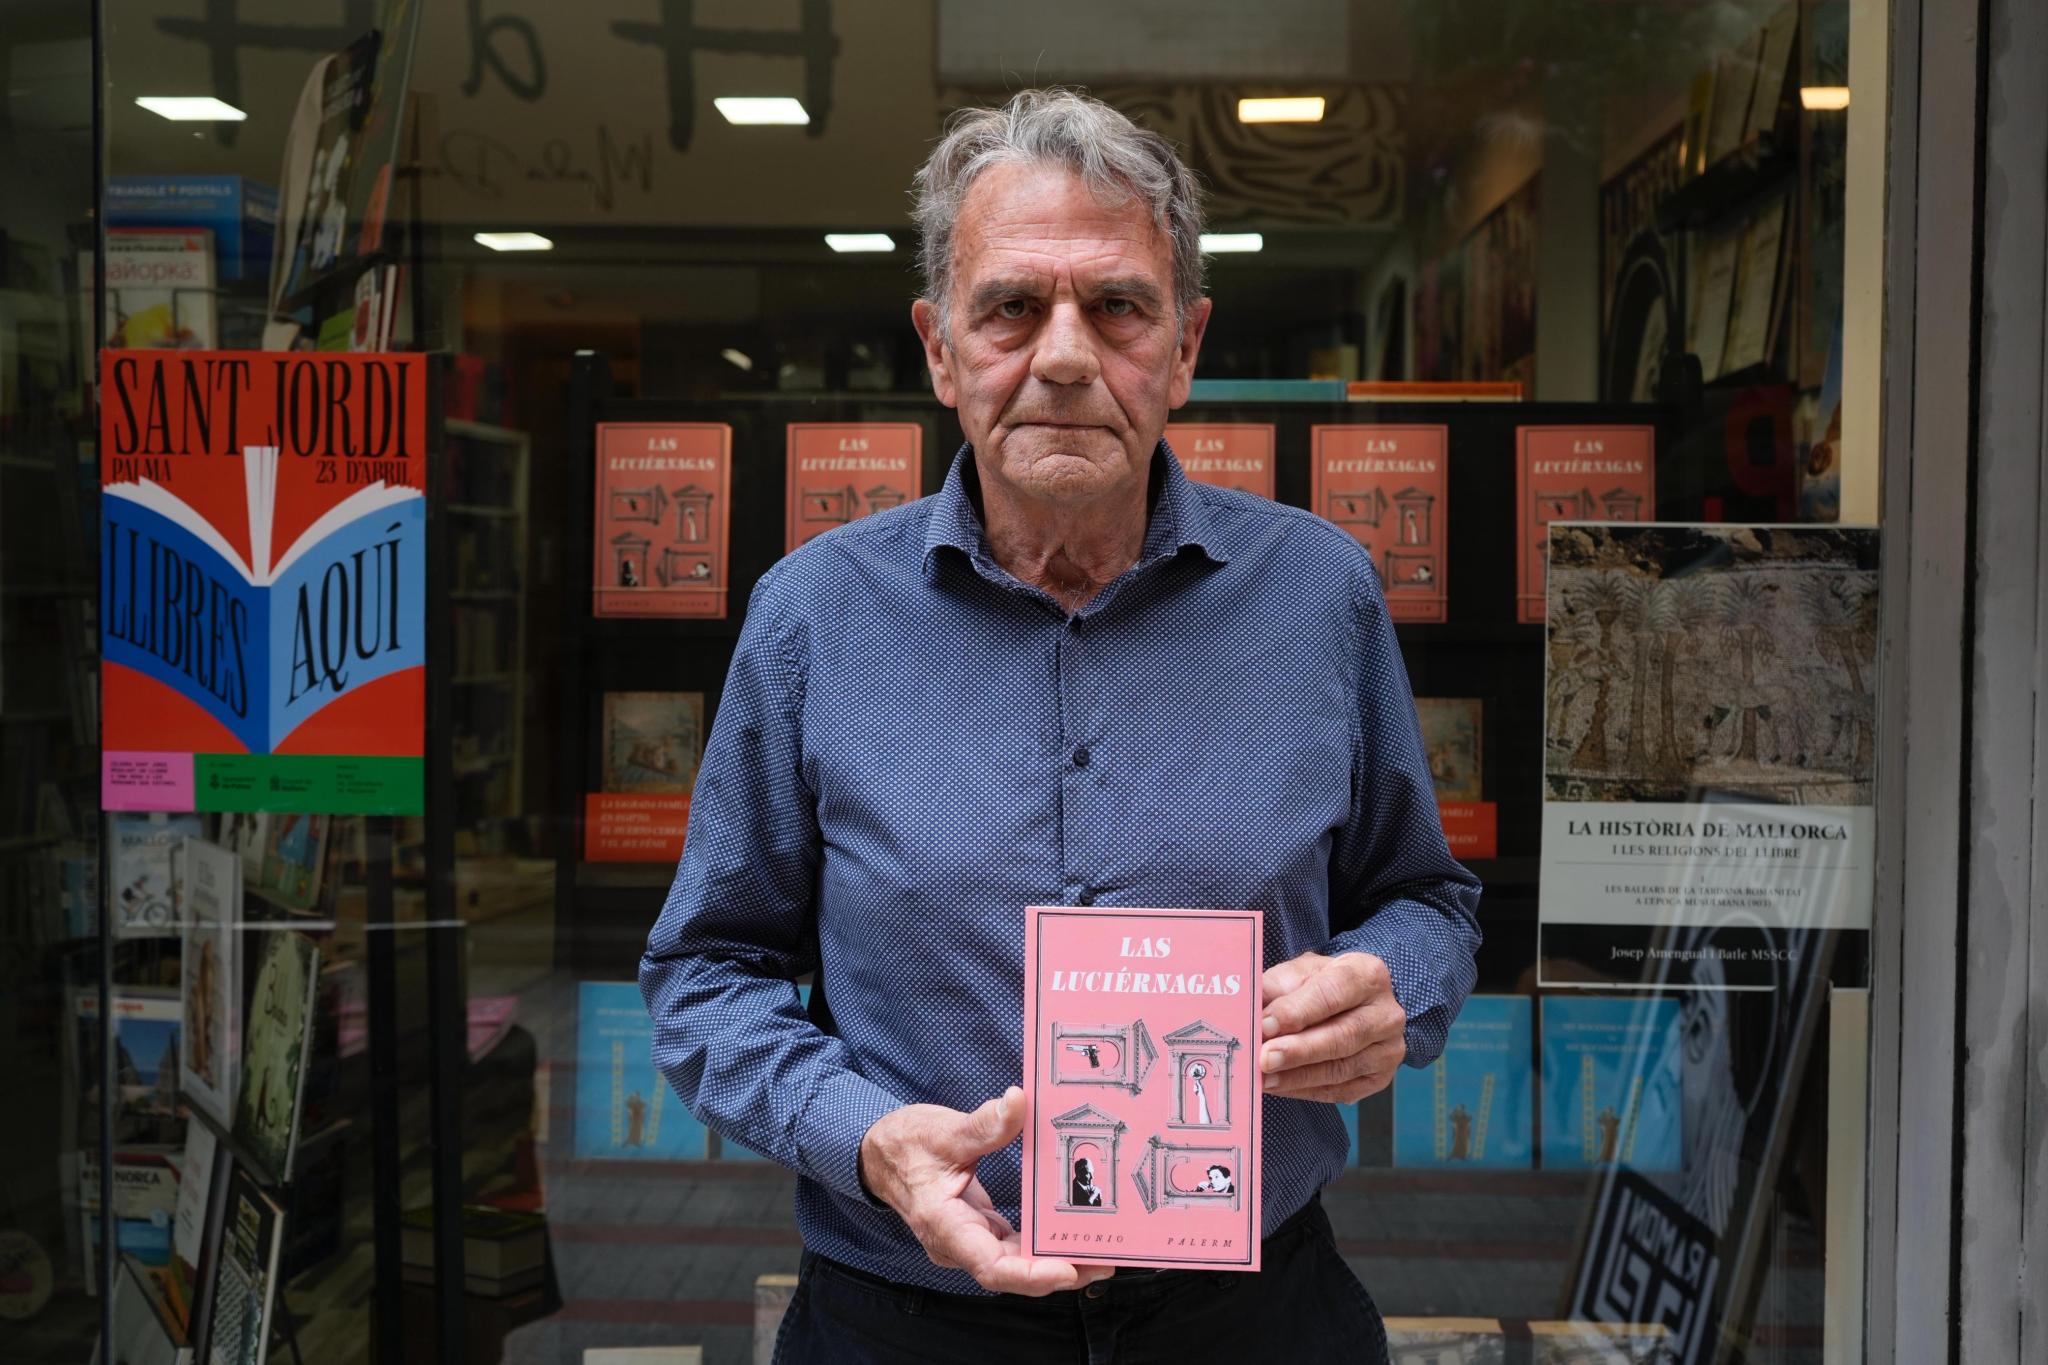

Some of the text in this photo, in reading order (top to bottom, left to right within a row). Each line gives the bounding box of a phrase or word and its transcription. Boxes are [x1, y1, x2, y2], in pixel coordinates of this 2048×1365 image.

[114, 358, 410, 457] SANT JORDI
[648, 437, 678, 451] LAS
[839, 437, 869, 451] LAS
[1194, 438, 1225, 452] LAS
[1366, 439, 1398, 453] LAS
[1573, 440, 1605, 454] LAS
[112, 458, 172, 481] PALMA
[610, 454, 716, 471] LUCIÉRNAGAS
[800, 455, 907, 471] LUCIÉRNAGAS
[1184, 455, 1264, 472] IÉRNAGAS
[1327, 457, 1436, 473] LUCIÉRNAGAS
[1534, 457, 1643, 474] LUCIÉRNAGAS
[316, 460, 412, 484] 23 D'ABRIL
[108, 521, 247, 719] LLIBRES
[285, 522, 402, 708] AQUÍ
[1568, 818, 1847, 840] LA HISTÒRIA DE MALLORCA
[1612, 844, 1801, 859] I LES RELIGIONS DEL LLIBRE
[1119, 936, 1171, 958] LAS
[1610, 946, 1644, 962] Josep
[1647, 946, 1706, 963] Amengual
[1718, 947, 1748, 960] Batle
[1751, 948, 1799, 961] MSSCC
[1050, 966, 1241, 996] LUCIÉRNAGAS
[1050, 1232, 1233, 1248] ANTONIO PALERM
